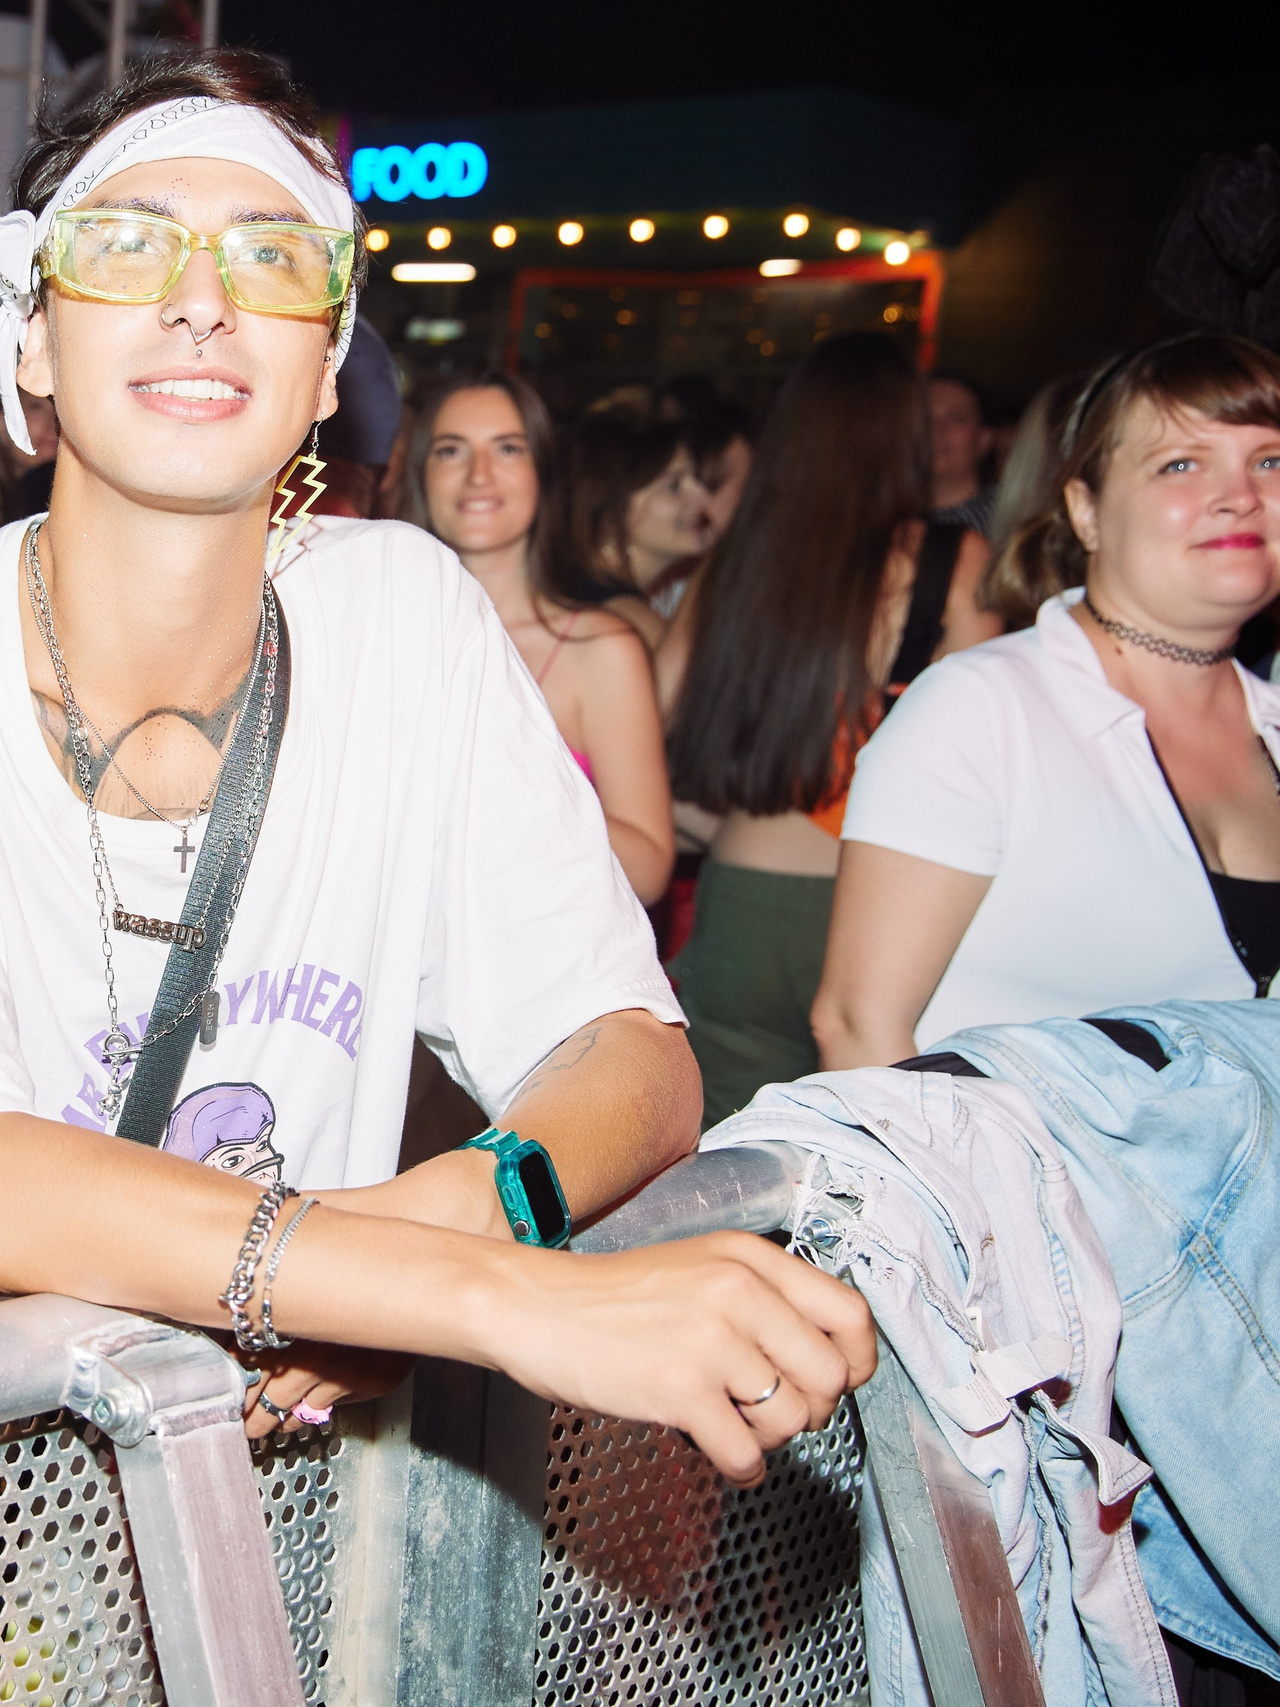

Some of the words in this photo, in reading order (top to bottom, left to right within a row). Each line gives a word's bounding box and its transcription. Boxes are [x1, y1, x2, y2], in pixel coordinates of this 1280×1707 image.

[351, 141, 488, 202] FOOD
[113, 909, 206, 953] wassup
[83, 962, 364, 1082] EVYWHER
